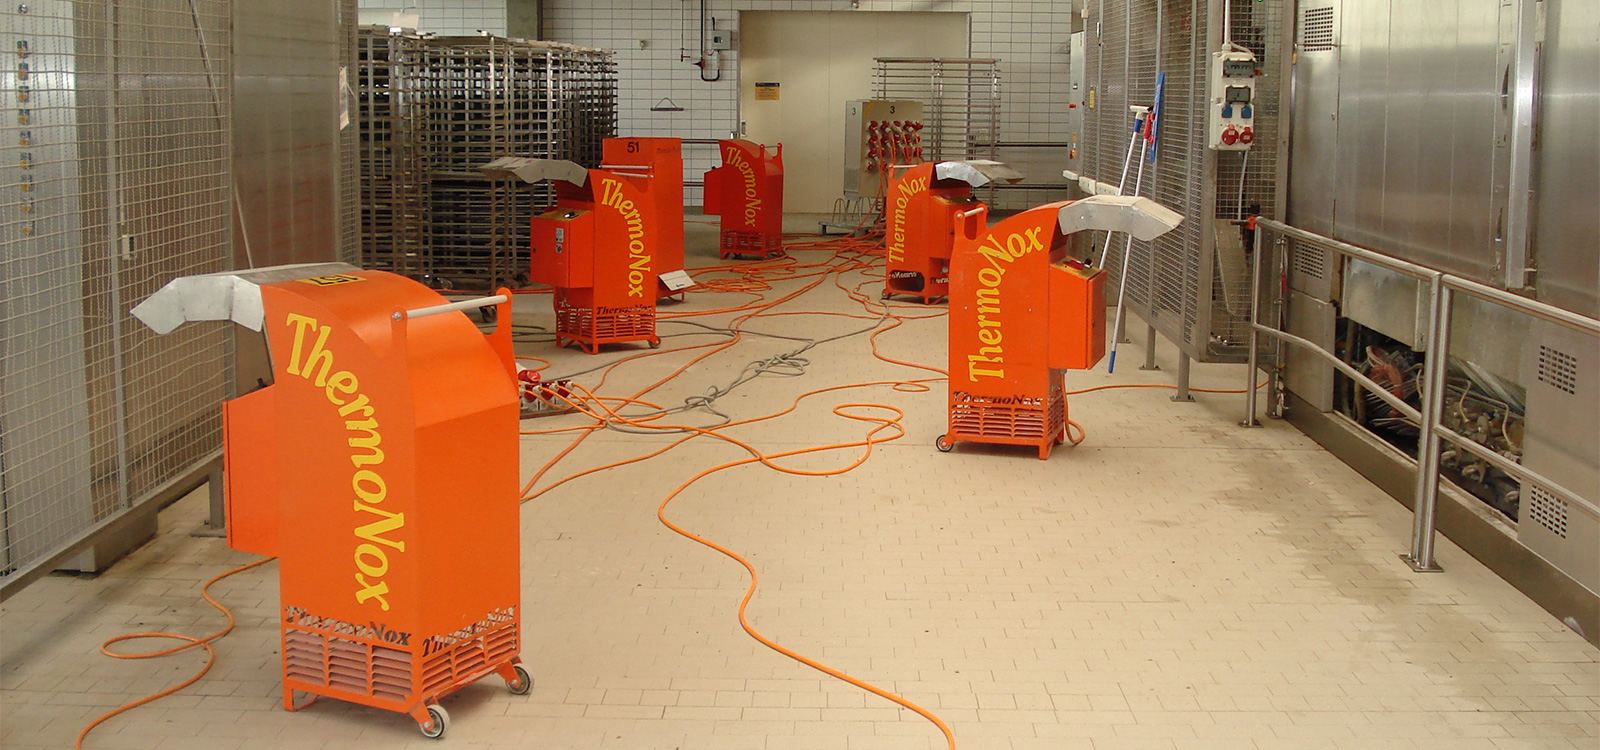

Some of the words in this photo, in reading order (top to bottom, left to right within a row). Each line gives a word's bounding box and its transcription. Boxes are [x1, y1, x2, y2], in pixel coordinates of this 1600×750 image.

[626, 141, 640, 154] 51
[889, 105, 896, 114] 3
[726, 146, 762, 227] ThermoNox
[889, 176, 926, 263] ThermoNox
[601, 178, 651, 298] ThermoNox
[968, 226, 1044, 382] ThermoNox
[286, 313, 405, 612] ThermoNox
